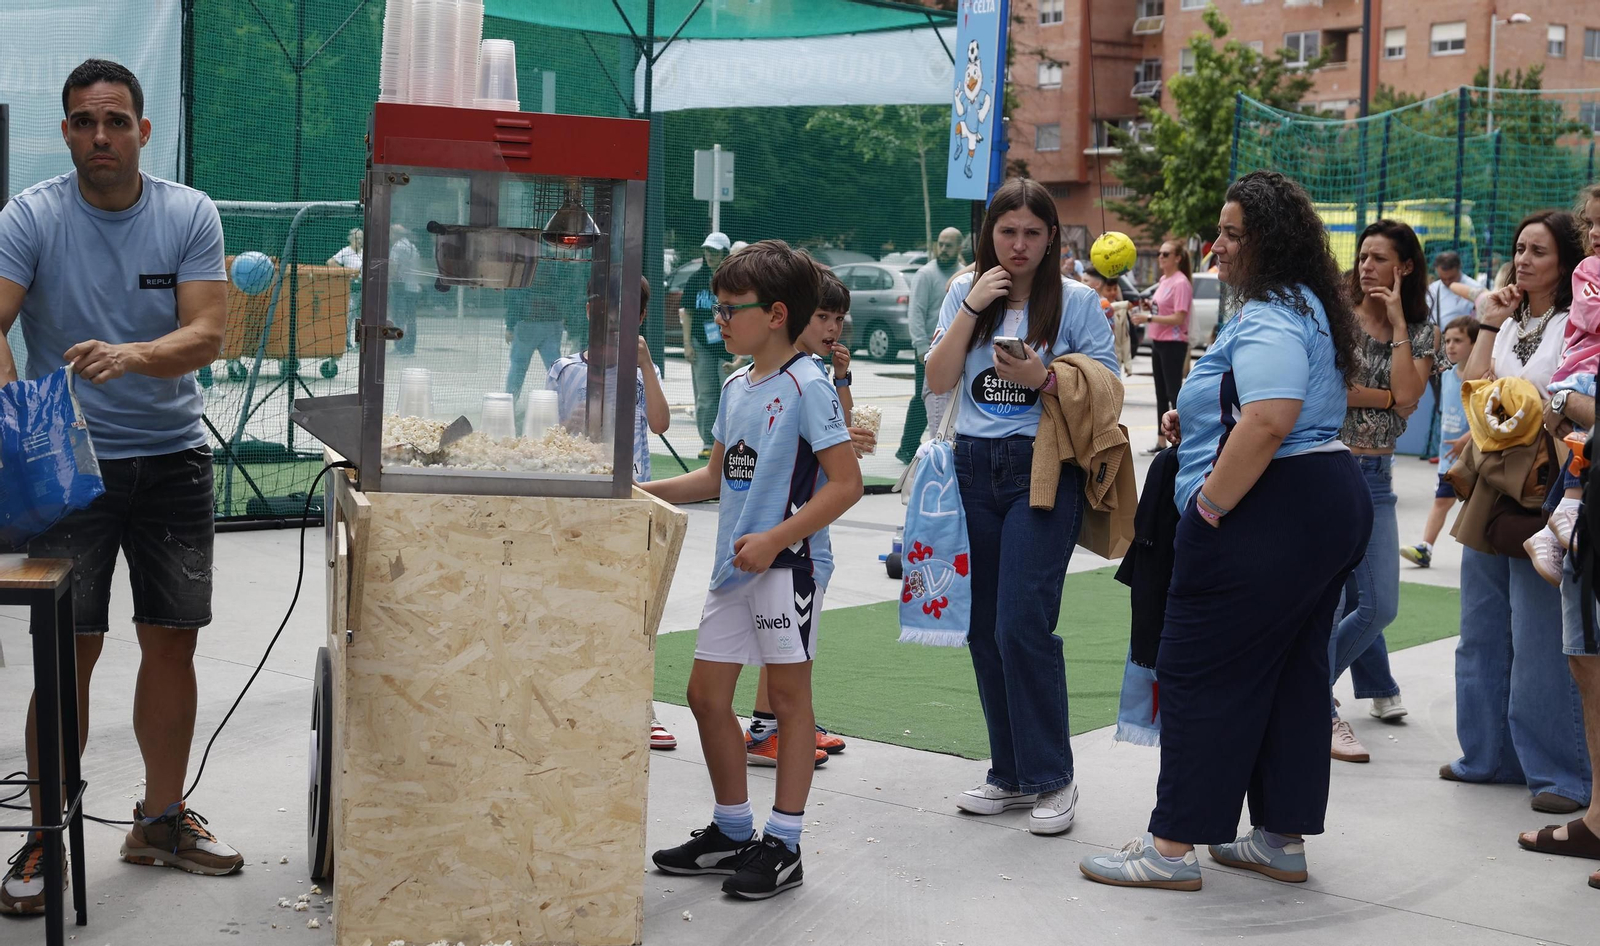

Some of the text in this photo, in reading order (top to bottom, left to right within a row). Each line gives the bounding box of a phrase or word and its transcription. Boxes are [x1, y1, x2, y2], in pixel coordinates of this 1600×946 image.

[973, 0, 995, 14] CELTA
[984, 388, 1026, 403] Galicia
[728, 453, 755, 467] Estrella
[728, 465, 753, 479] Galicia
[756, 613, 791, 630] Siweb
